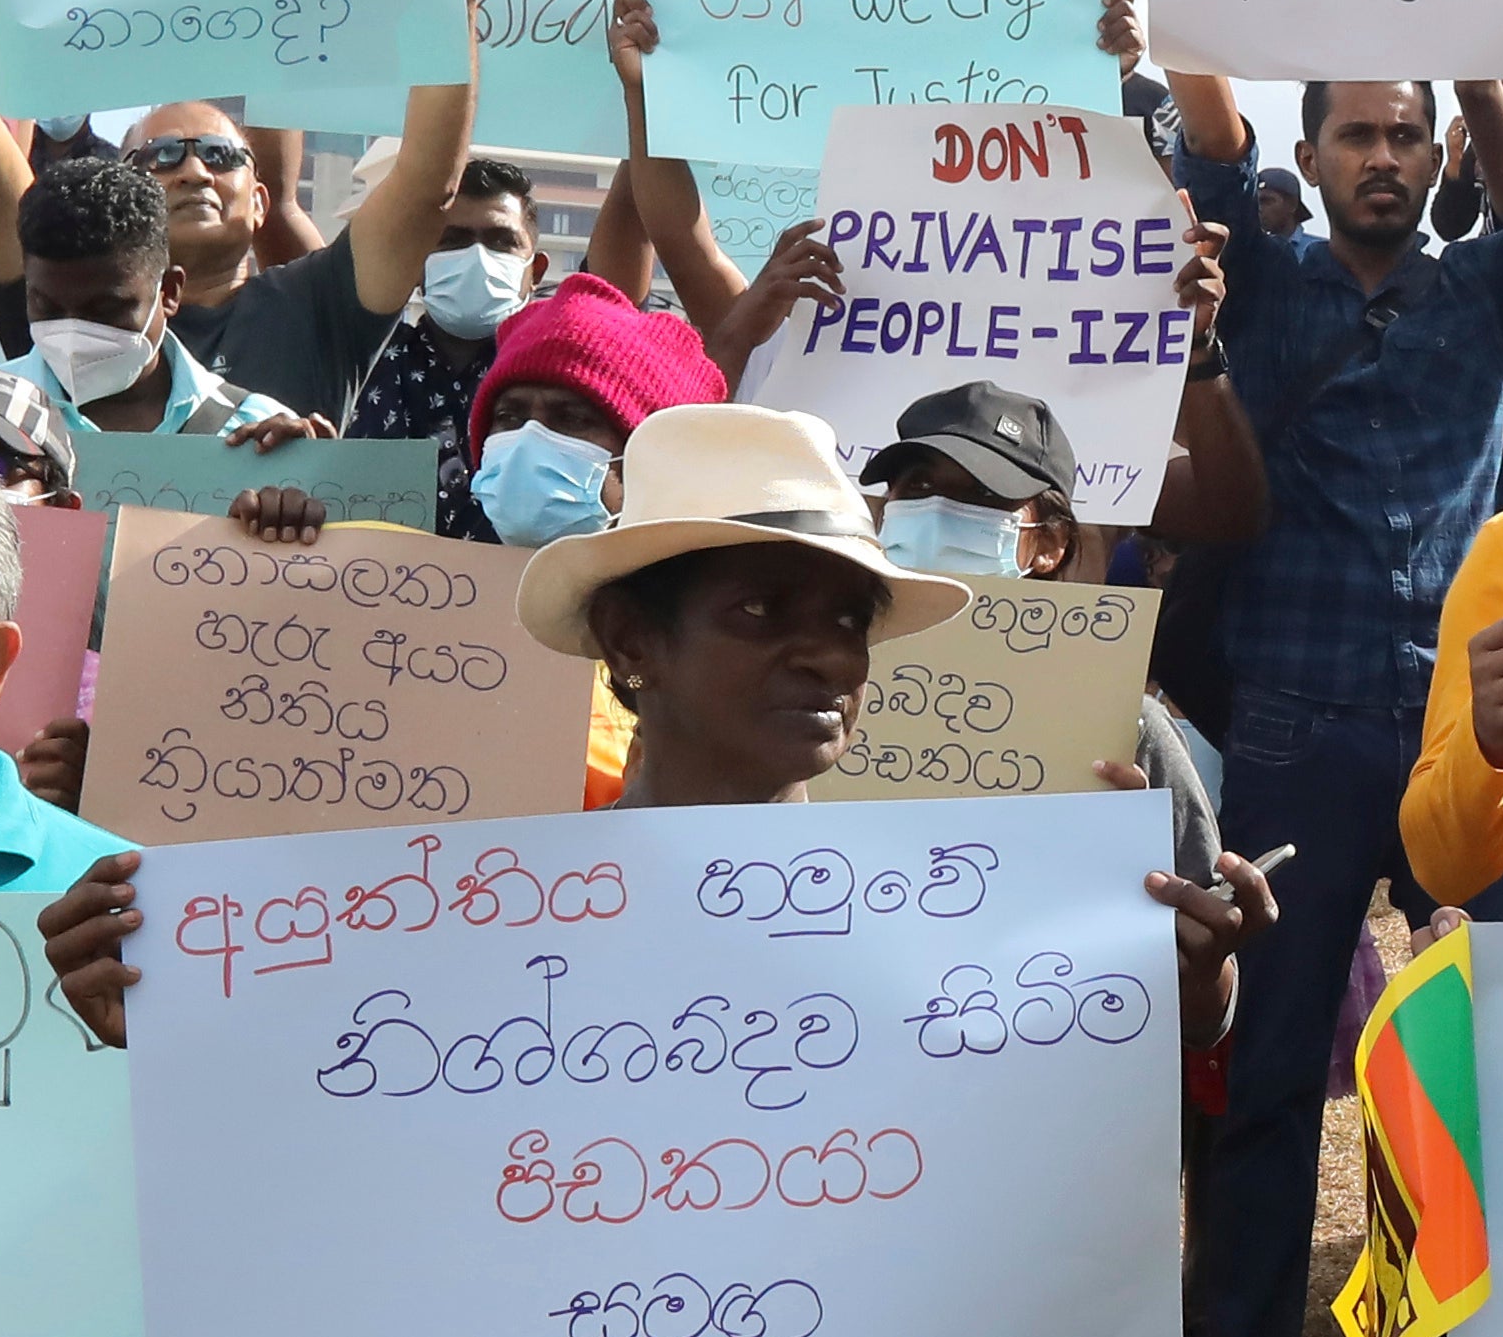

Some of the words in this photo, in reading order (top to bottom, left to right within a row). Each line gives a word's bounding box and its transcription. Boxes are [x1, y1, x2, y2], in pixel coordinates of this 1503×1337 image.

[727, 64, 819, 124] for
[932, 113, 1091, 183] DON'T
[827, 210, 1175, 281] PRIVATISE
[804, 293, 1191, 365] PEOPLE-IZE
